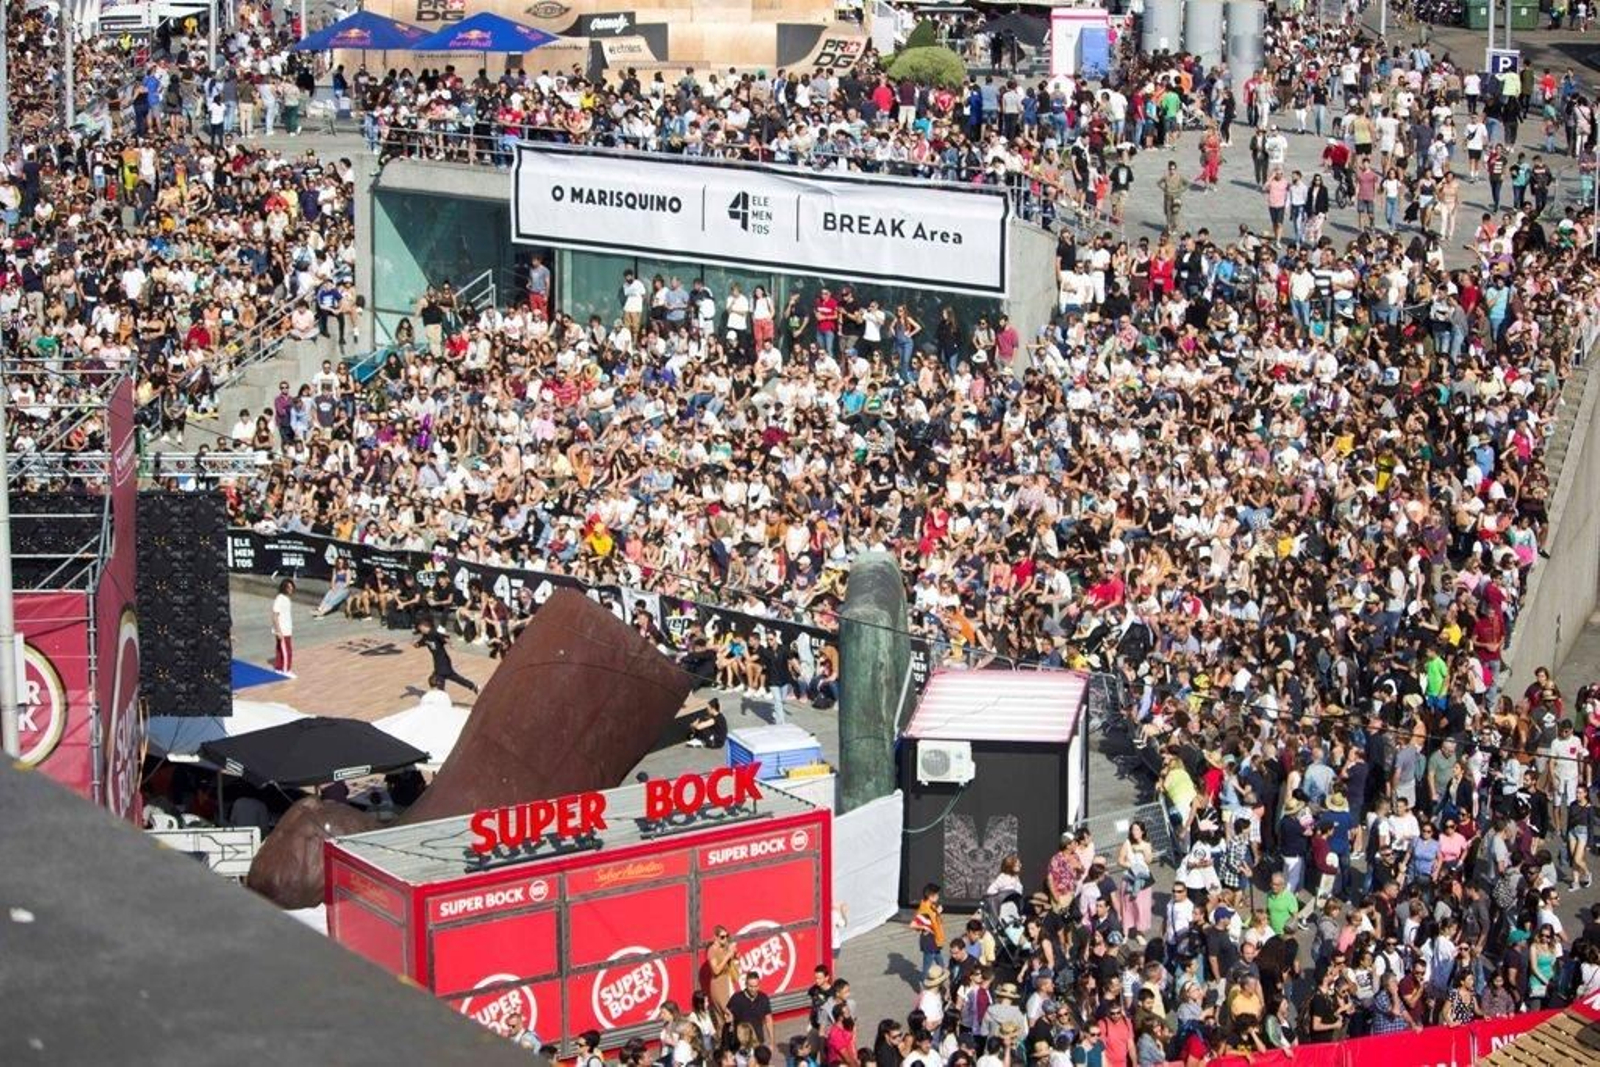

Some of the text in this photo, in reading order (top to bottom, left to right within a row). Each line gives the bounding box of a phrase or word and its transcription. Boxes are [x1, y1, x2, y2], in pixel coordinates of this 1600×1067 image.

[416, 10, 465, 21] DG
[812, 52, 856, 68] DG
[1499, 57, 1512, 72] P
[551, 185, 682, 214] O MARISQUINO
[728, 191, 749, 231] 4
[752, 195, 769, 207] ELE
[752, 210, 773, 221] MEN
[752, 223, 770, 235] TOS
[823, 211, 963, 245] BREAK Area
[234, 538, 251, 547] ELE
[234, 549, 255, 558] MEN
[235, 559, 254, 568] TOS
[470, 761, 763, 853] SUPER BOCK
[707, 837, 786, 867] SUPER BOCK
[440, 895, 484, 917] SUPER
[485, 887, 525, 908] BOCK
[738, 935, 784, 975] UPER
[600, 962, 656, 1006] SUPER
[470, 989, 523, 1025] UPER
[608, 980, 659, 1019] BOCK
